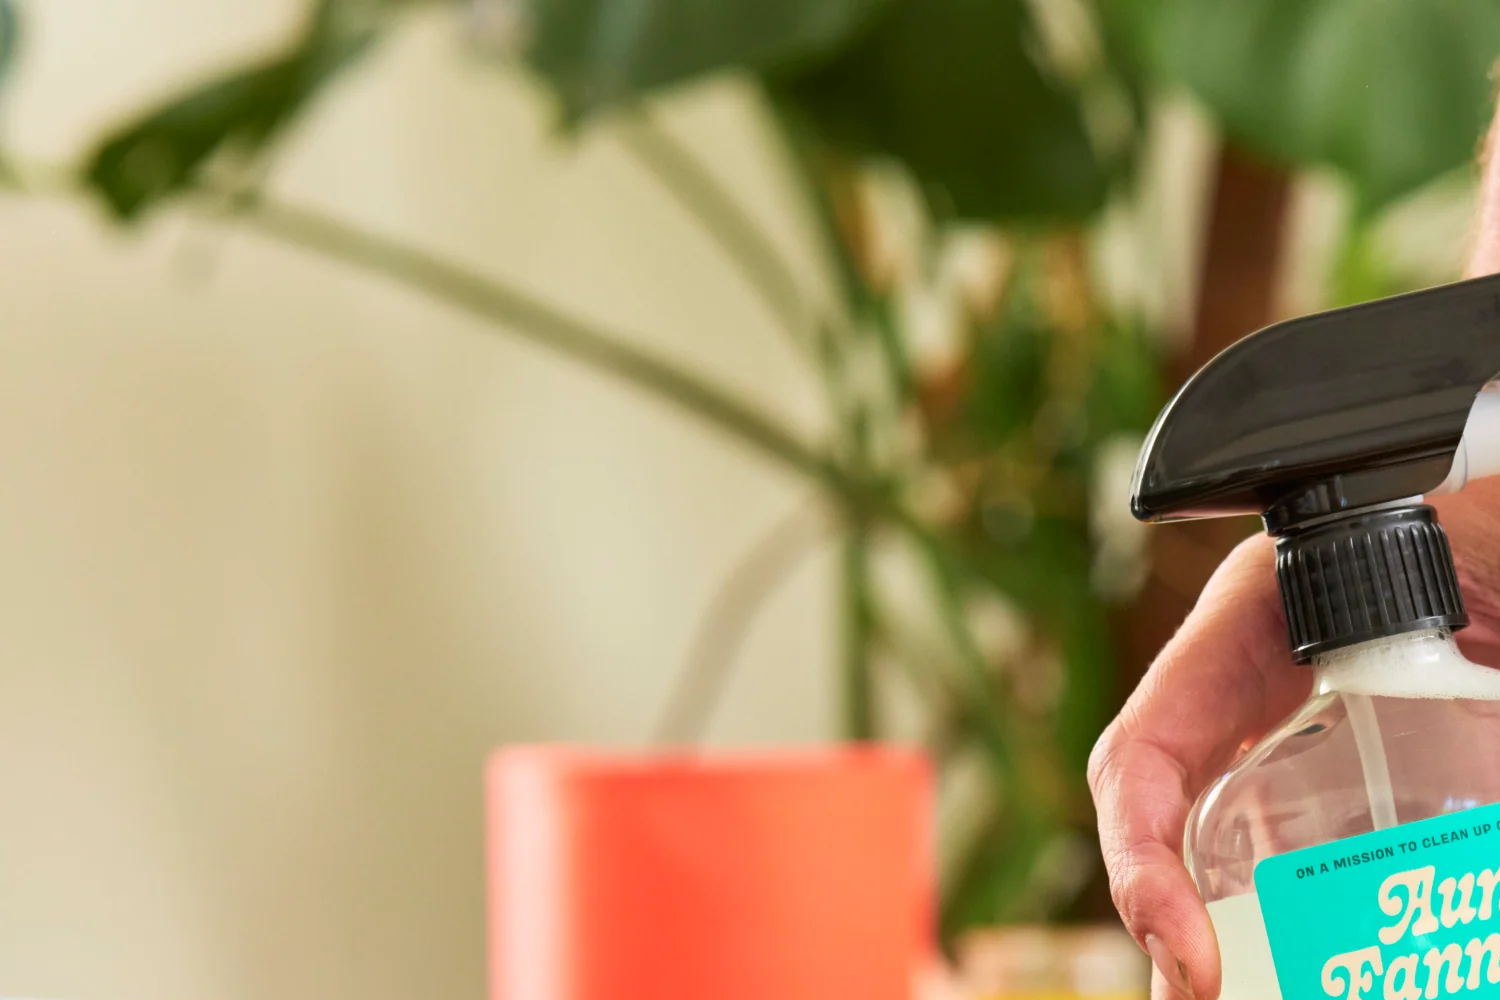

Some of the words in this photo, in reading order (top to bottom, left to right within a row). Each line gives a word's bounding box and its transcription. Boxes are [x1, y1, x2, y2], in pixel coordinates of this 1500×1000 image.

[1296, 866, 1315, 879] ON
[1320, 863, 1329, 874] A
[1333, 846, 1394, 870] MISSION
[1397, 841, 1417, 854] TO
[1422, 828, 1469, 848] CLEAN
[1473, 823, 1491, 836] UP
